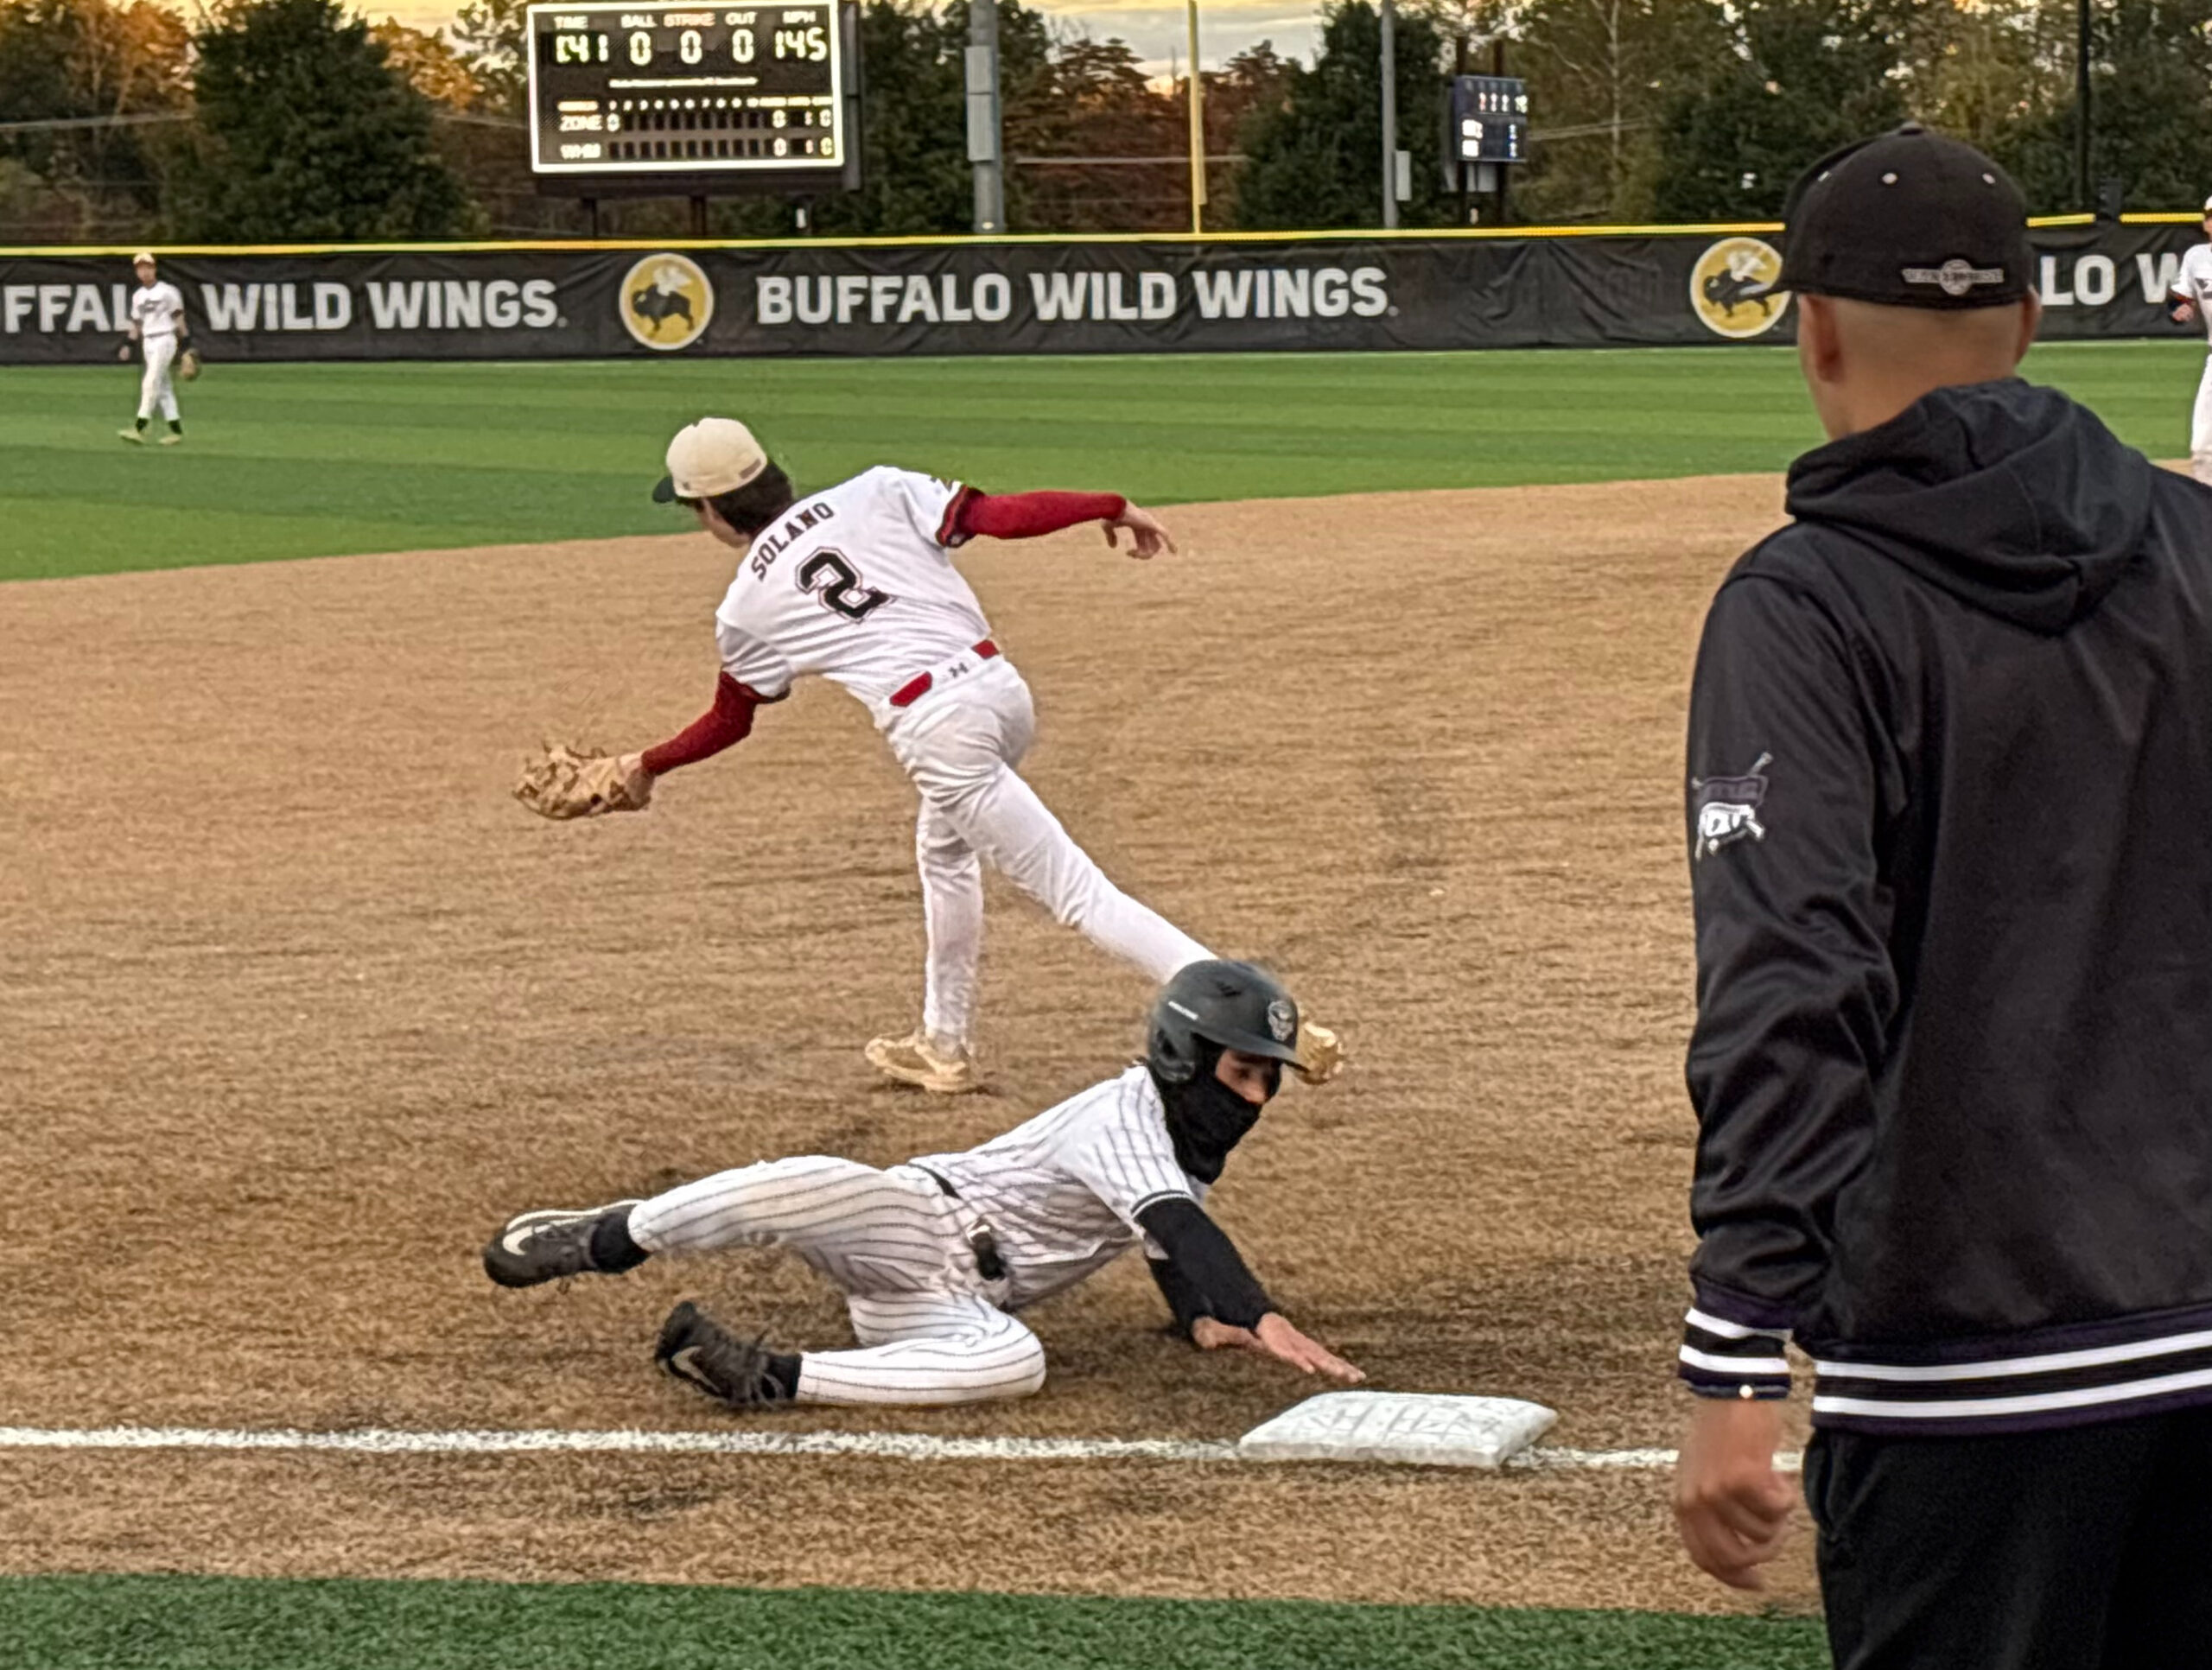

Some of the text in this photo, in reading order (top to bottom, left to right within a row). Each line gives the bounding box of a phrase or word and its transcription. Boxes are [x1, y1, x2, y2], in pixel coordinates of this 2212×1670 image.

[554, 10, 817, 29] TIME BALL STRIKE OUT MPH
[630, 31, 652, 66] 0
[680, 29, 702, 64] 0
[732, 29, 754, 63] 0
[775, 27, 827, 61] 145
[201, 283, 352, 331] WILD
[366, 279, 558, 330] WINGS
[757, 267, 1389, 324] BUFFALO WILD WINGS
[750, 502, 835, 581] SOLANO
[796, 547, 896, 624] 2
